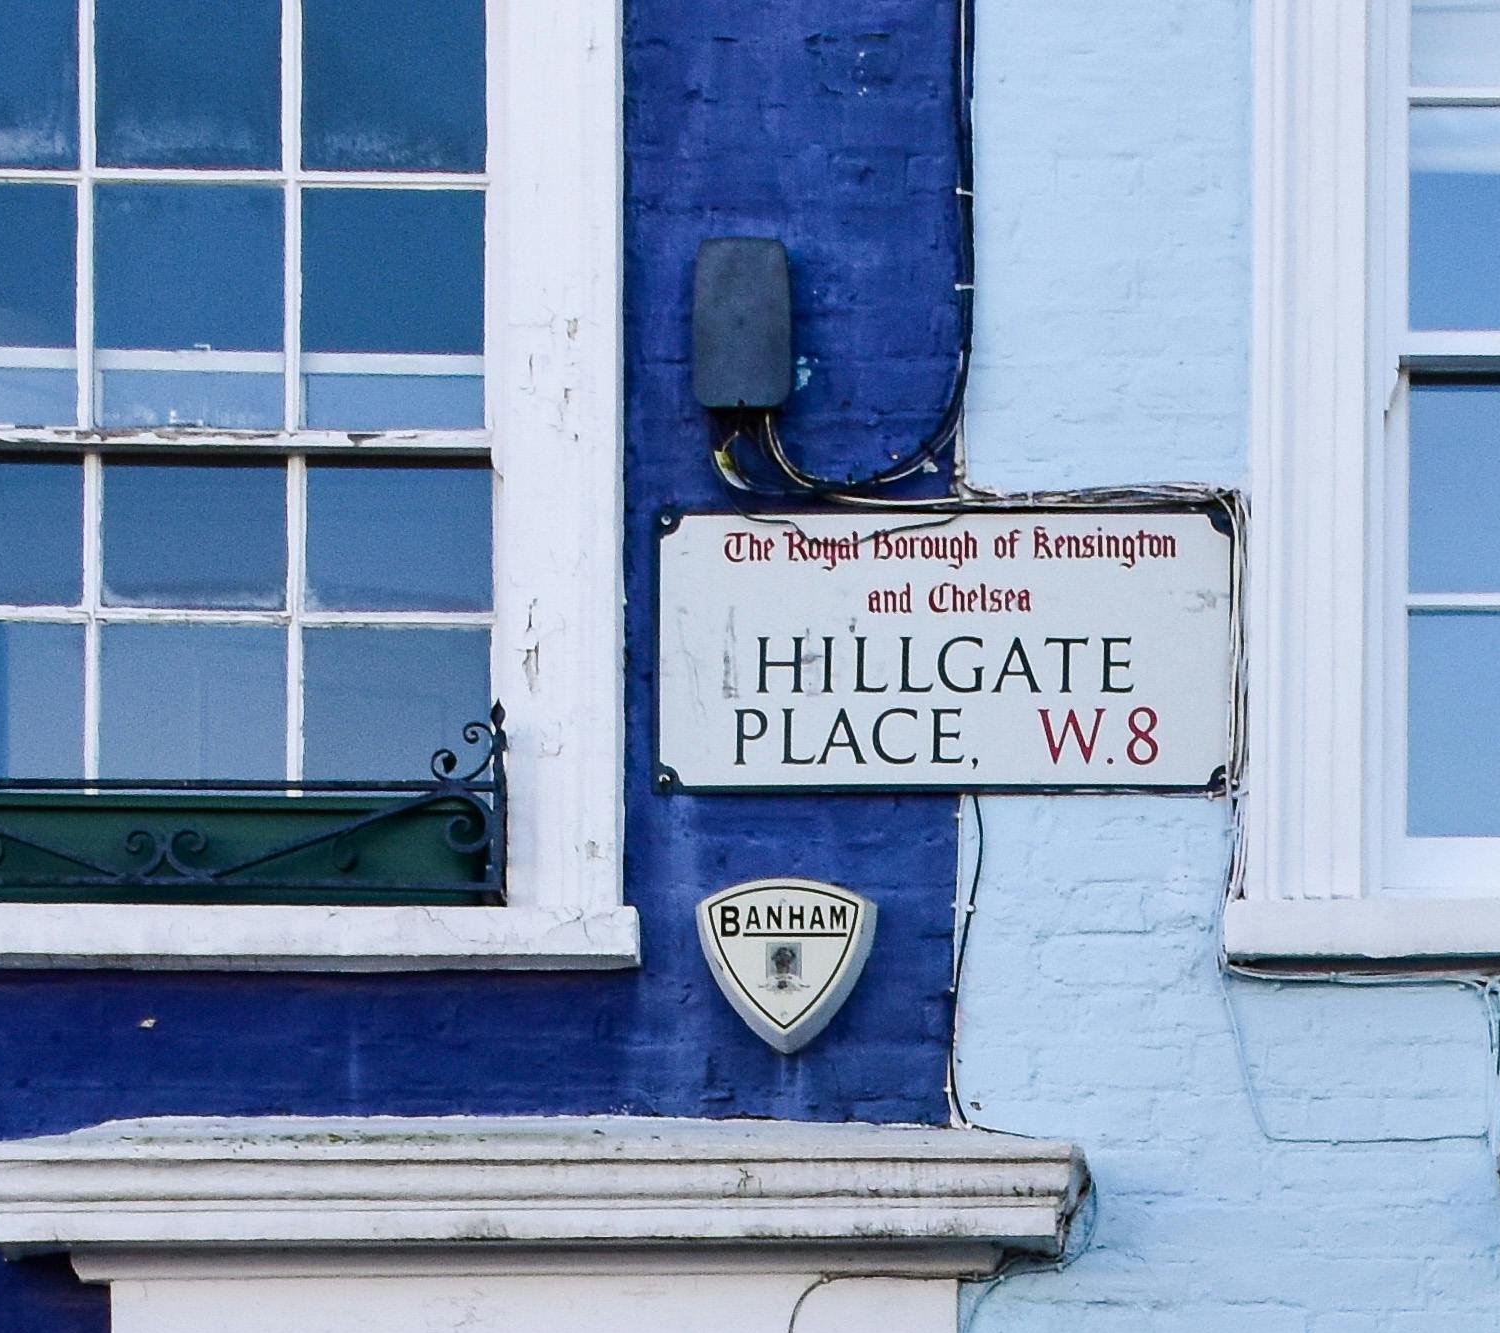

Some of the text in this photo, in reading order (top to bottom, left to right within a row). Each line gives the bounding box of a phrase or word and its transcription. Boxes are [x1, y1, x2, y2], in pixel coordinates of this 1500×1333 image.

[723, 525, 1177, 571] The Royal Borough of Kensington
[867, 582, 1032, 614] and Chelsea
[756, 635, 1136, 694] HILLGATE
[732, 705, 1160, 770] PLACE, W.8
[719, 904, 848, 938] BANHAM
